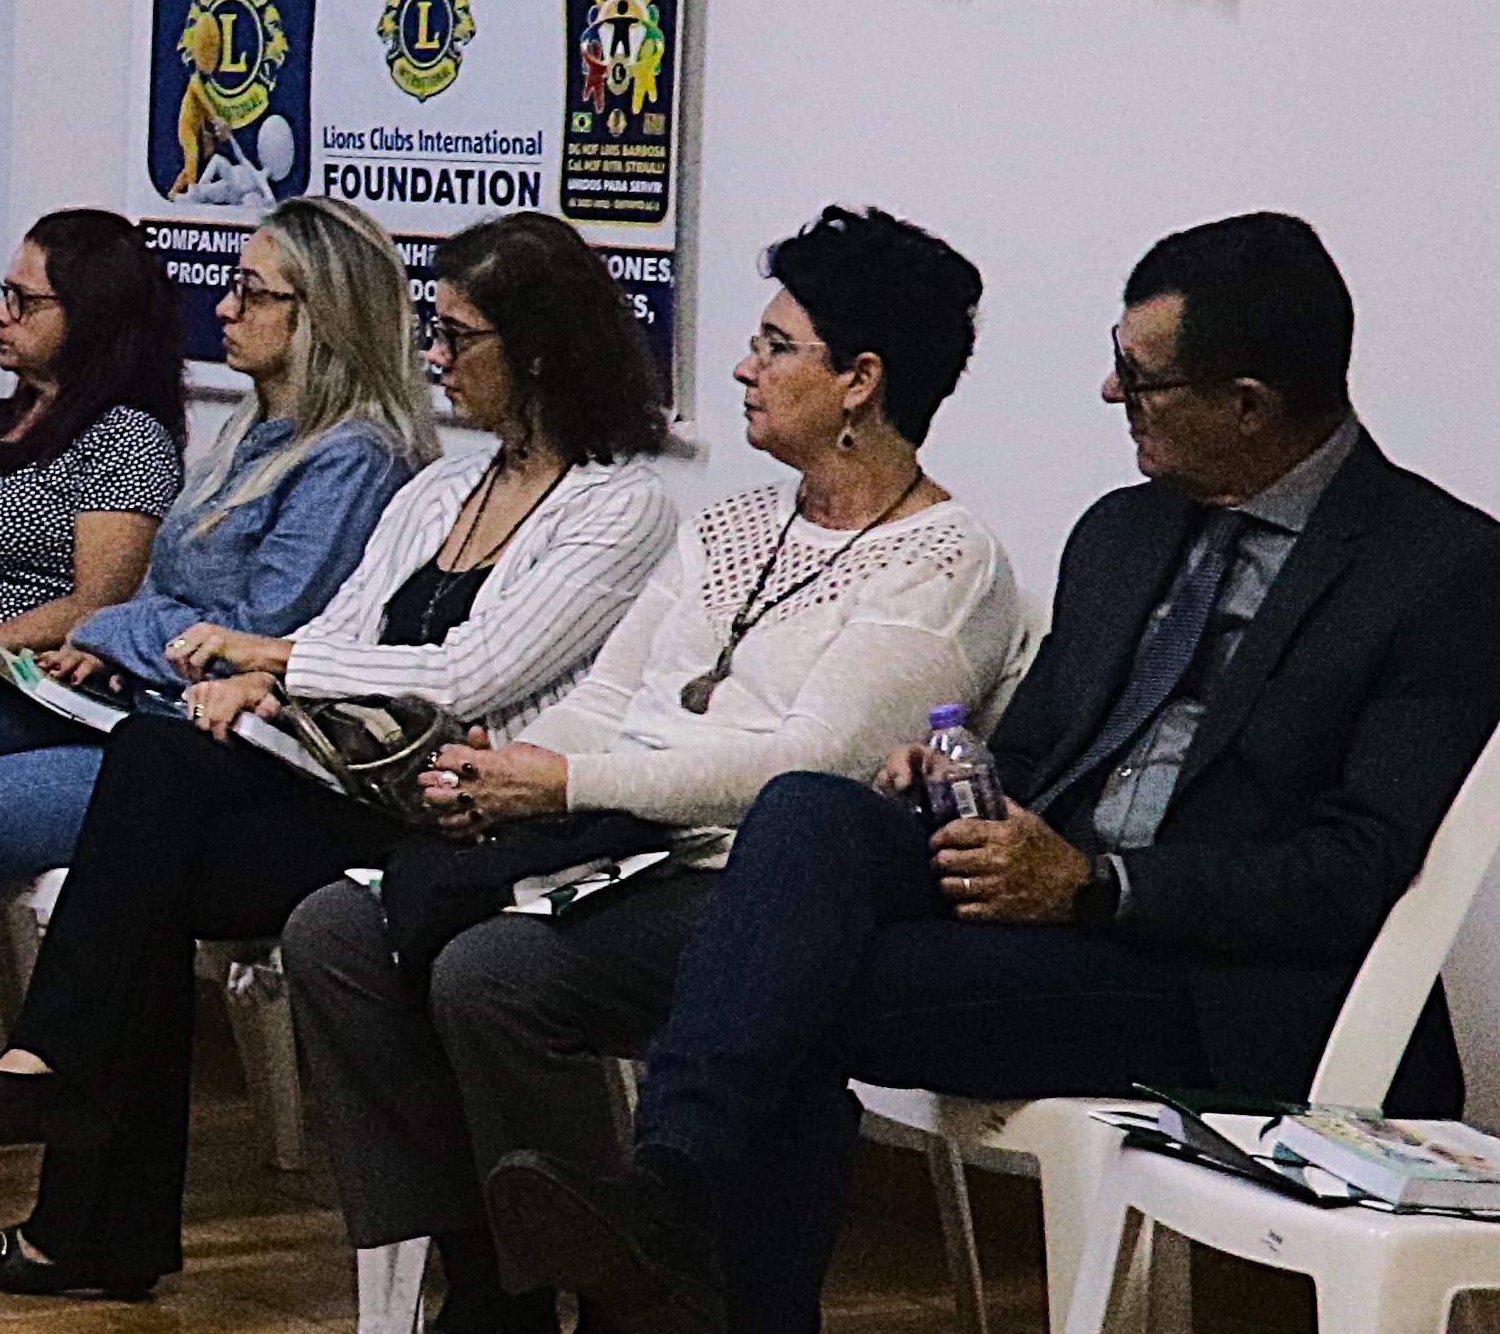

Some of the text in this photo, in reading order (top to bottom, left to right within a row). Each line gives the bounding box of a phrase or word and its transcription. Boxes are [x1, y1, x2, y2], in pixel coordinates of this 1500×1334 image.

[218, 13, 248, 73] L
[414, 1, 440, 50] L
[323, 125, 543, 156] Lions Clubs International
[323, 163, 541, 207] FOUNDATION
